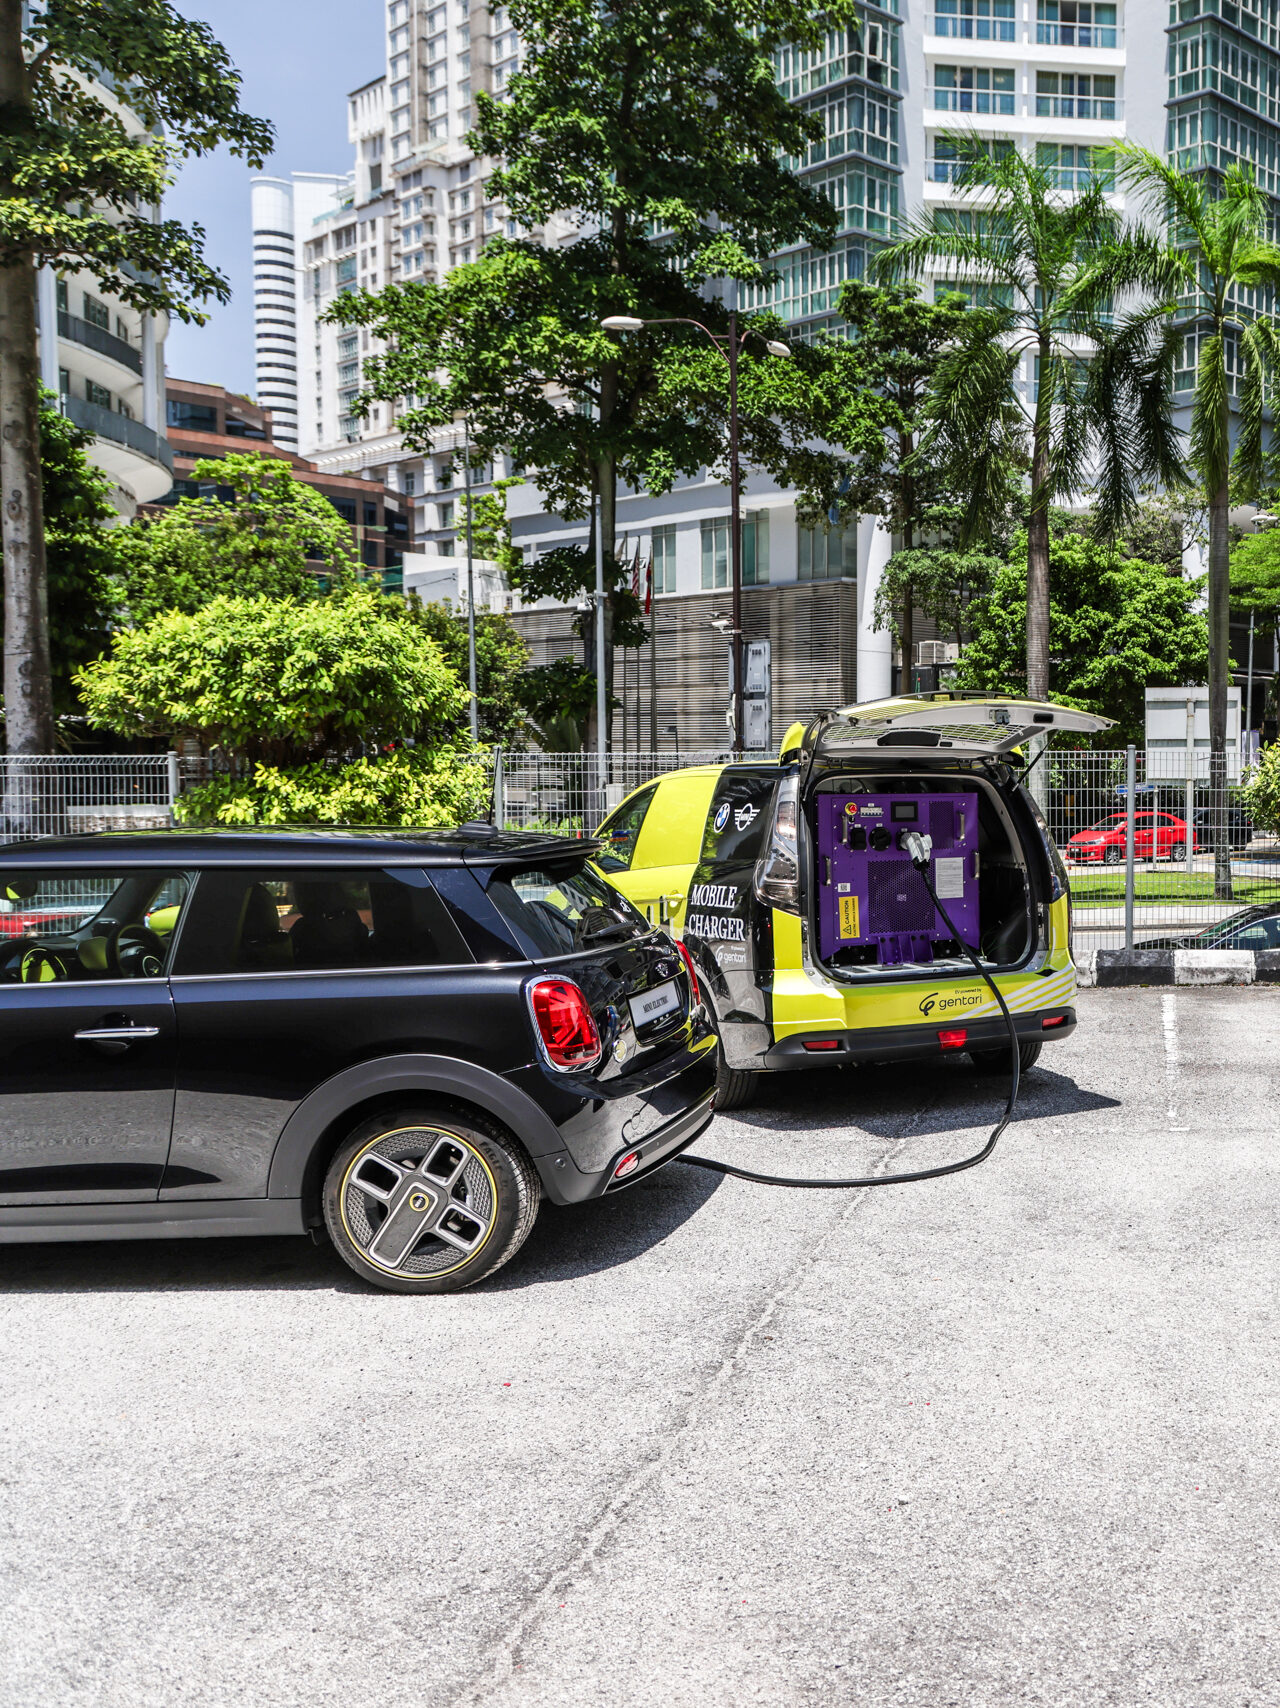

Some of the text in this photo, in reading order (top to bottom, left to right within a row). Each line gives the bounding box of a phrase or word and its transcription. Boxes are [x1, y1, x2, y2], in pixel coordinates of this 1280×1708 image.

[691, 884, 738, 909] MOBILE
[688, 913, 746, 942] CHARGER
[724, 952, 747, 964] gentari
[939, 994, 983, 1011] gentari
